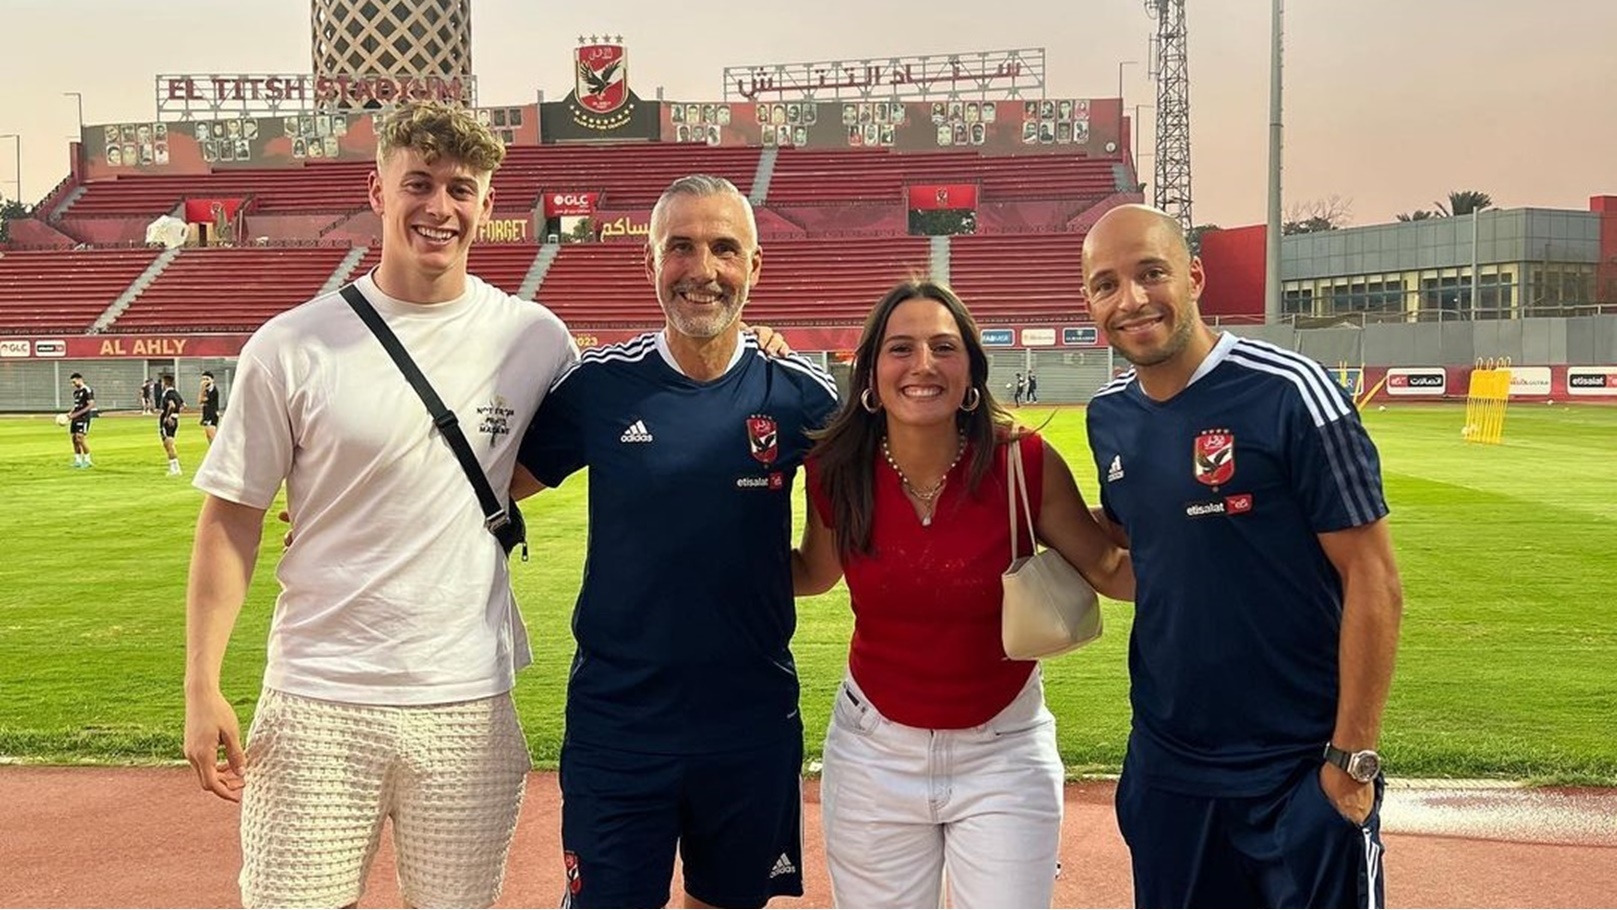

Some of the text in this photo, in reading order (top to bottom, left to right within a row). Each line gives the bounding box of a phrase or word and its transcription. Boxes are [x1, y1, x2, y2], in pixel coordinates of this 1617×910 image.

[168, 76, 463, 100] EL TITSH STADIUM
[564, 195, 589, 206] GLC
[479, 219, 528, 242] FORGET
[601, 217, 651, 243] ساكم
[100, 339, 187, 355] AL AHLY
[576, 337, 598, 347] 023
[1572, 376, 1604, 386] etisalat
[620, 433, 653, 443] adidas
[736, 477, 769, 487] etisalat
[1186, 502, 1225, 516] etisalat
